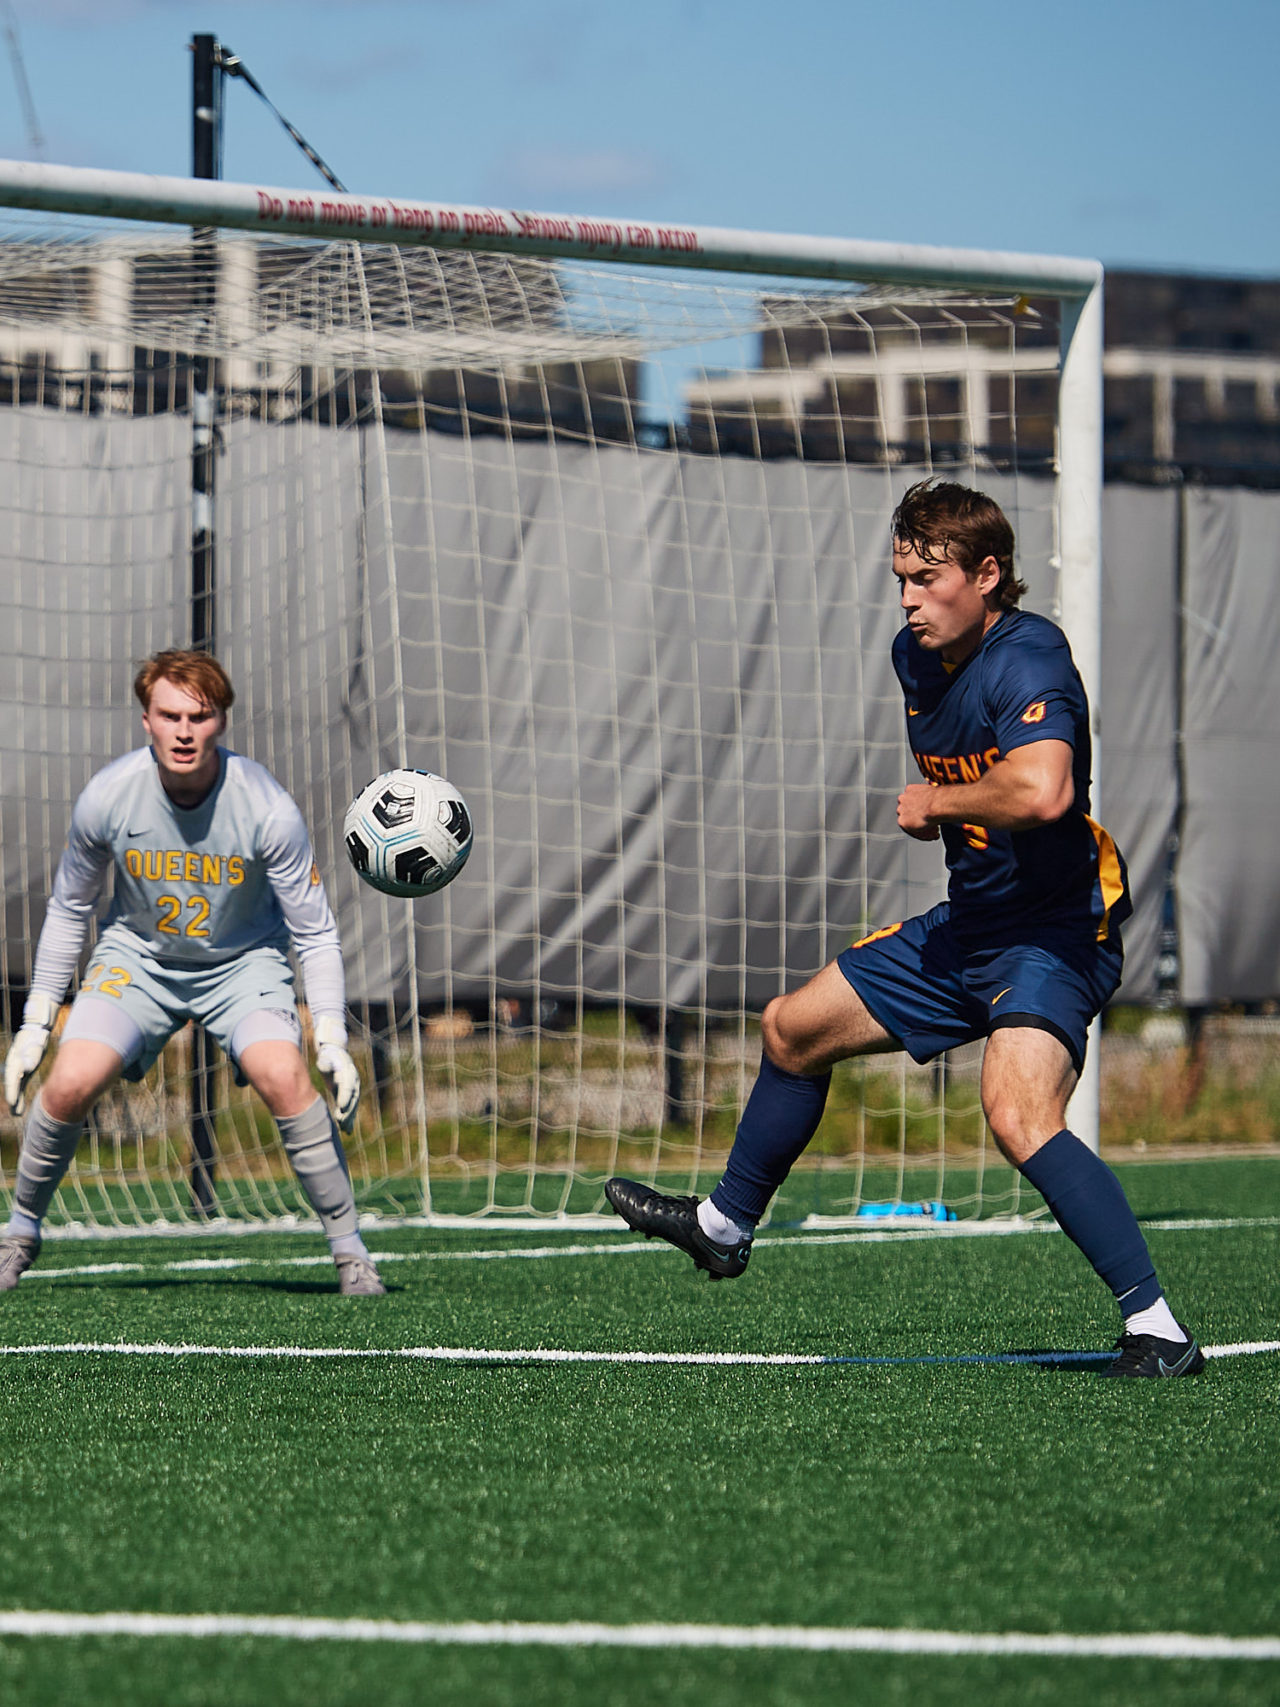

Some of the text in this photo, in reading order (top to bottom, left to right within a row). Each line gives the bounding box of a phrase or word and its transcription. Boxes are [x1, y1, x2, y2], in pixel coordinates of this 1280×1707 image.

[257, 191, 283, 221] Do
[286, 197, 314, 224] not
[320, 202, 367, 227] move
[370, 206, 386, 229] or
[387, 199, 434, 240] hang
[438, 210, 460, 234] on
[511, 211, 574, 243] Serious
[575, 217, 622, 253] injury
[627, 226, 654, 249] can
[915, 747, 1000, 786] UEEN'S
[126, 849, 245, 885] QUEEN'S
[157, 895, 210, 937] 22
